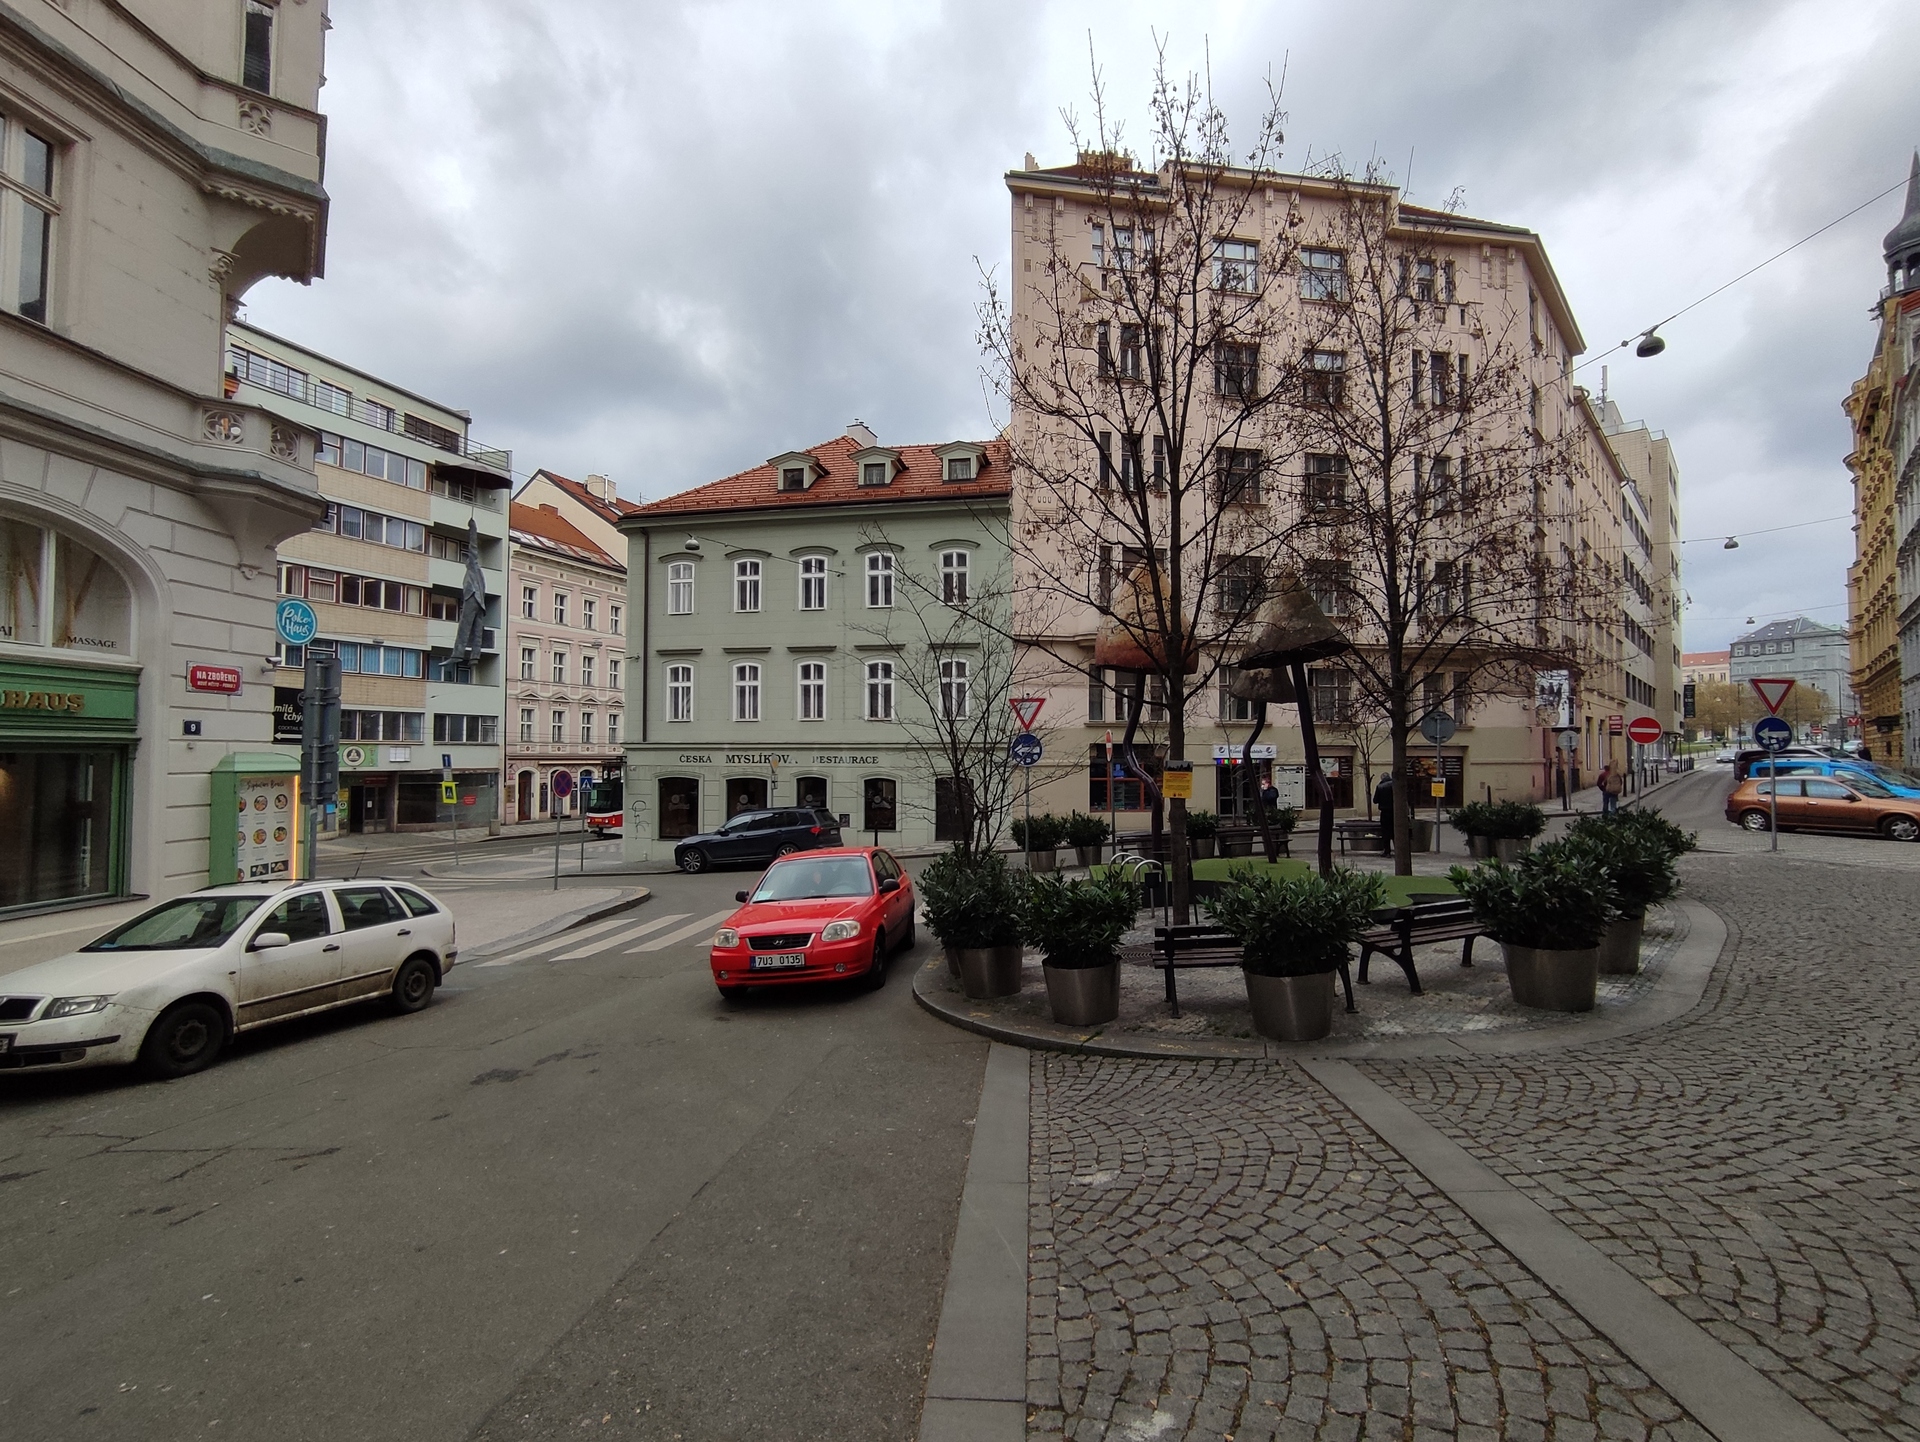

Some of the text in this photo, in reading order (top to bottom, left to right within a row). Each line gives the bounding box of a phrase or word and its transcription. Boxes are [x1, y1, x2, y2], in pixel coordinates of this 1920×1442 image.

[282, 606, 311, 626] Poke
[286, 620, 309, 636] Haus
[67, 636, 117, 648] MASSAGE
[196, 671, 238, 683] NA ZBOŘENCI
[3, 690, 85, 713] HAUS
[275, 703, 293, 713] milá
[190, 723, 196, 732] 9
[679, 754, 712, 763] ČESKÁ
[812, 755, 880, 764] RESTAURACE
[757, 956, 774, 966] 7U3
[779, 955, 801, 965] 0135
